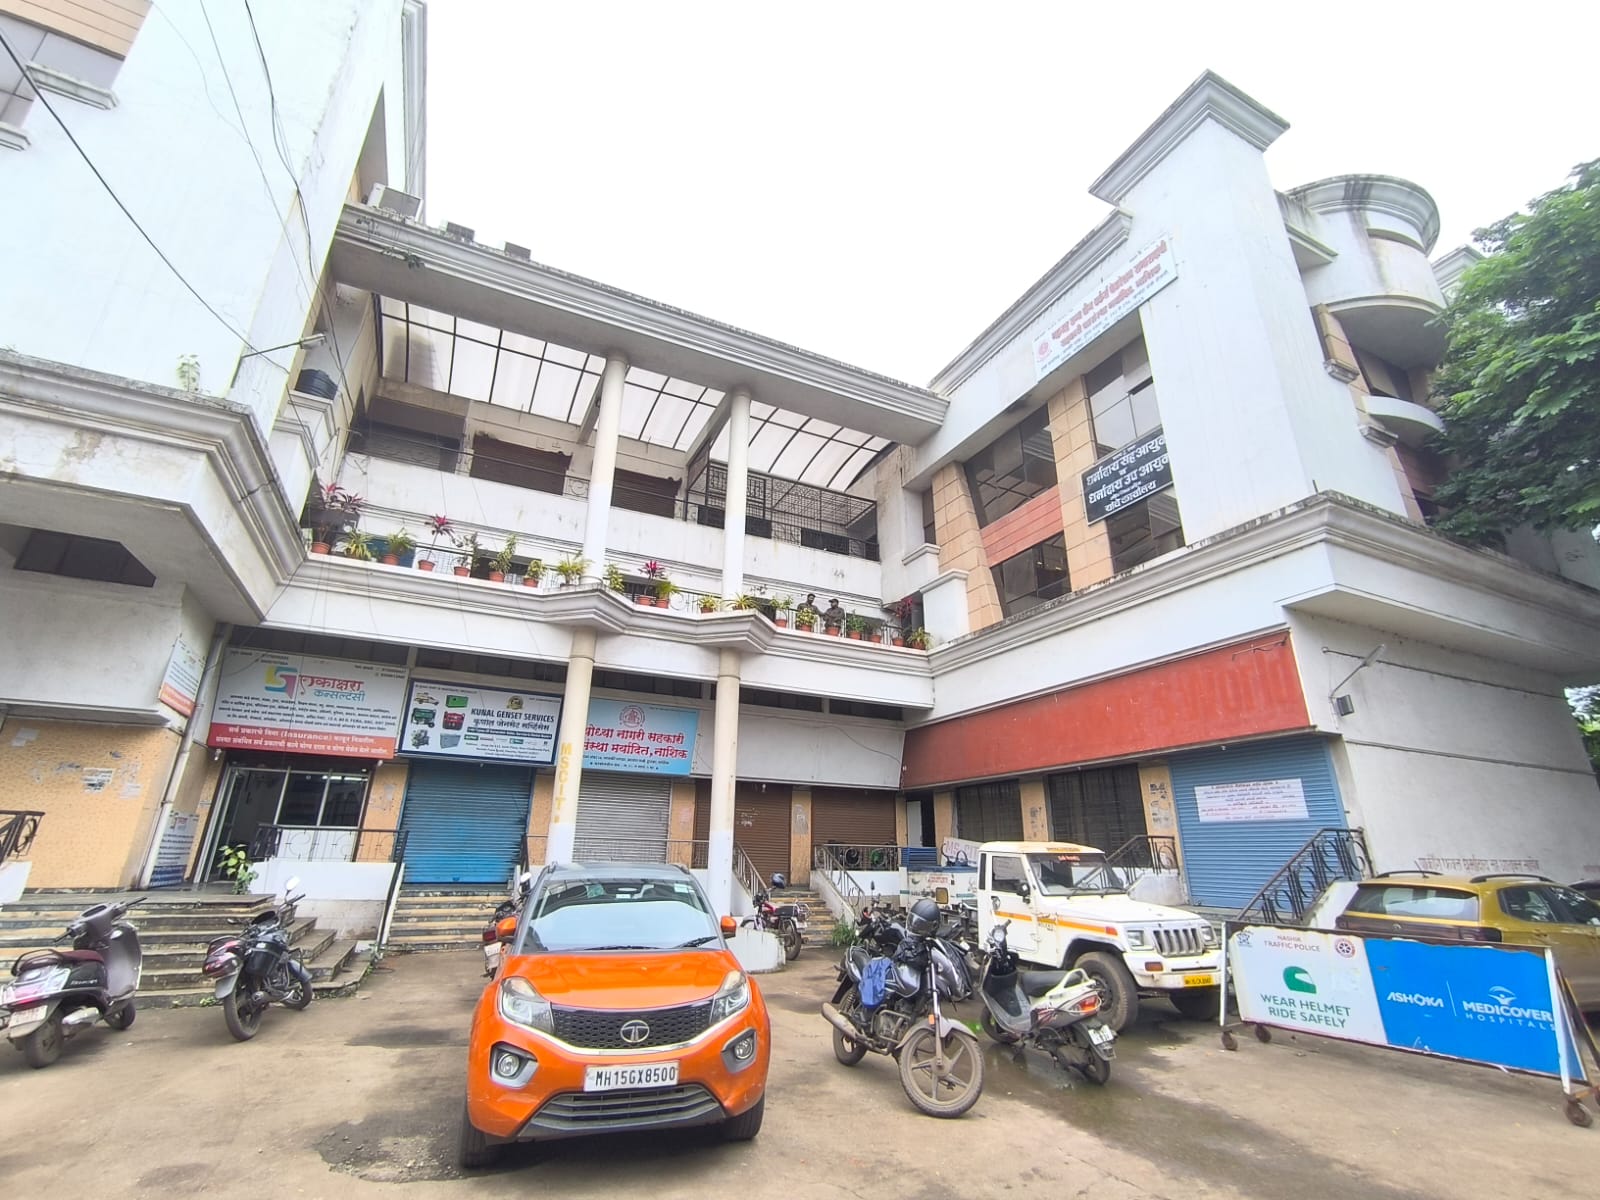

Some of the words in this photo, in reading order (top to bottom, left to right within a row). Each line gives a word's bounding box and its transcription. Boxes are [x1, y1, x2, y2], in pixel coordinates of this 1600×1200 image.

[471, 708, 495, 717] KUNAL
[496, 710, 523, 720] GENSET
[524, 713, 555, 723] SERVICES
[584, 723, 614, 738] योध्या
[616, 728, 645, 741] नागरी
[647, 731, 684, 745] सहकारी
[1264, 940, 1293, 950] TRAFFIC
[1294, 943, 1320, 952] POLICE
[1260, 993, 1296, 1008] WEAR
[1299, 1000, 1351, 1017] HELMET
[1462, 1001, 1554, 1022] MEDICOVER
[1268, 1006, 1297, 1020] RIDE
[1300, 1011, 1346, 1028] SAFELY
[595, 1066, 676, 1086] MH15GX8500
